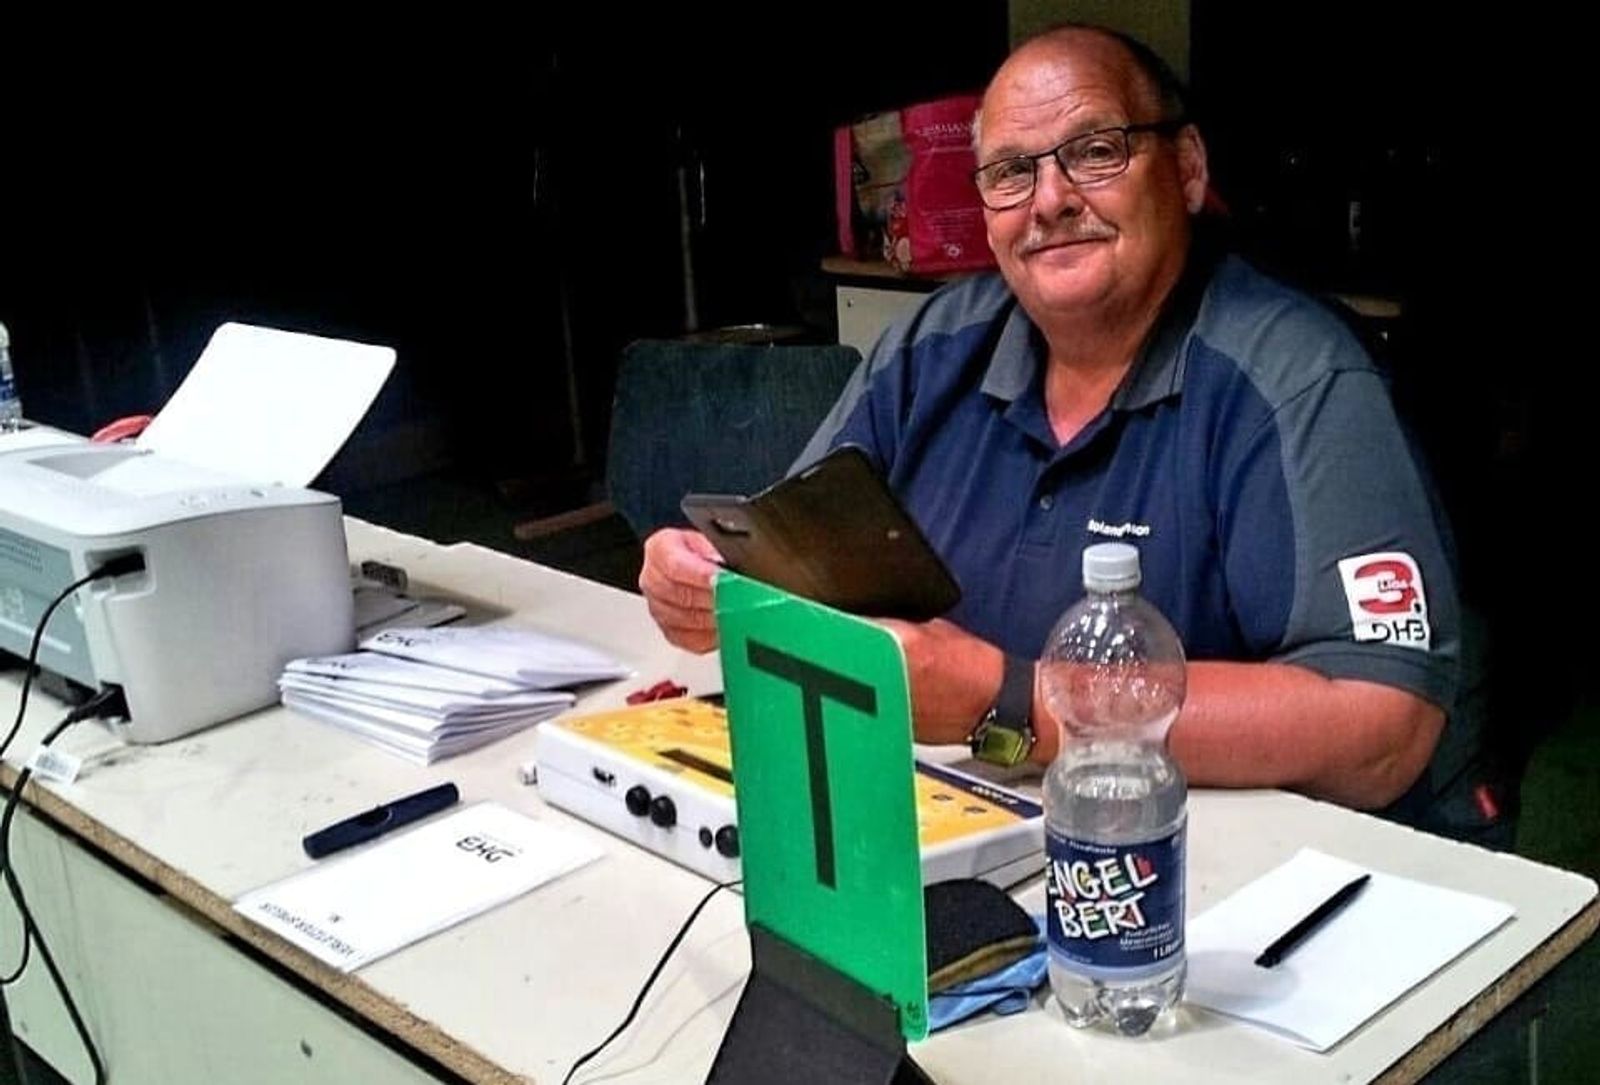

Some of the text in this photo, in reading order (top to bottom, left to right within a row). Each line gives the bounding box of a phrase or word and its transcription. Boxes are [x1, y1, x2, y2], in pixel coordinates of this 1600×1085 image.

[1366, 619, 1426, 642] DHB
[747, 640, 877, 890] T
[1055, 892, 1146, 939] BERT
